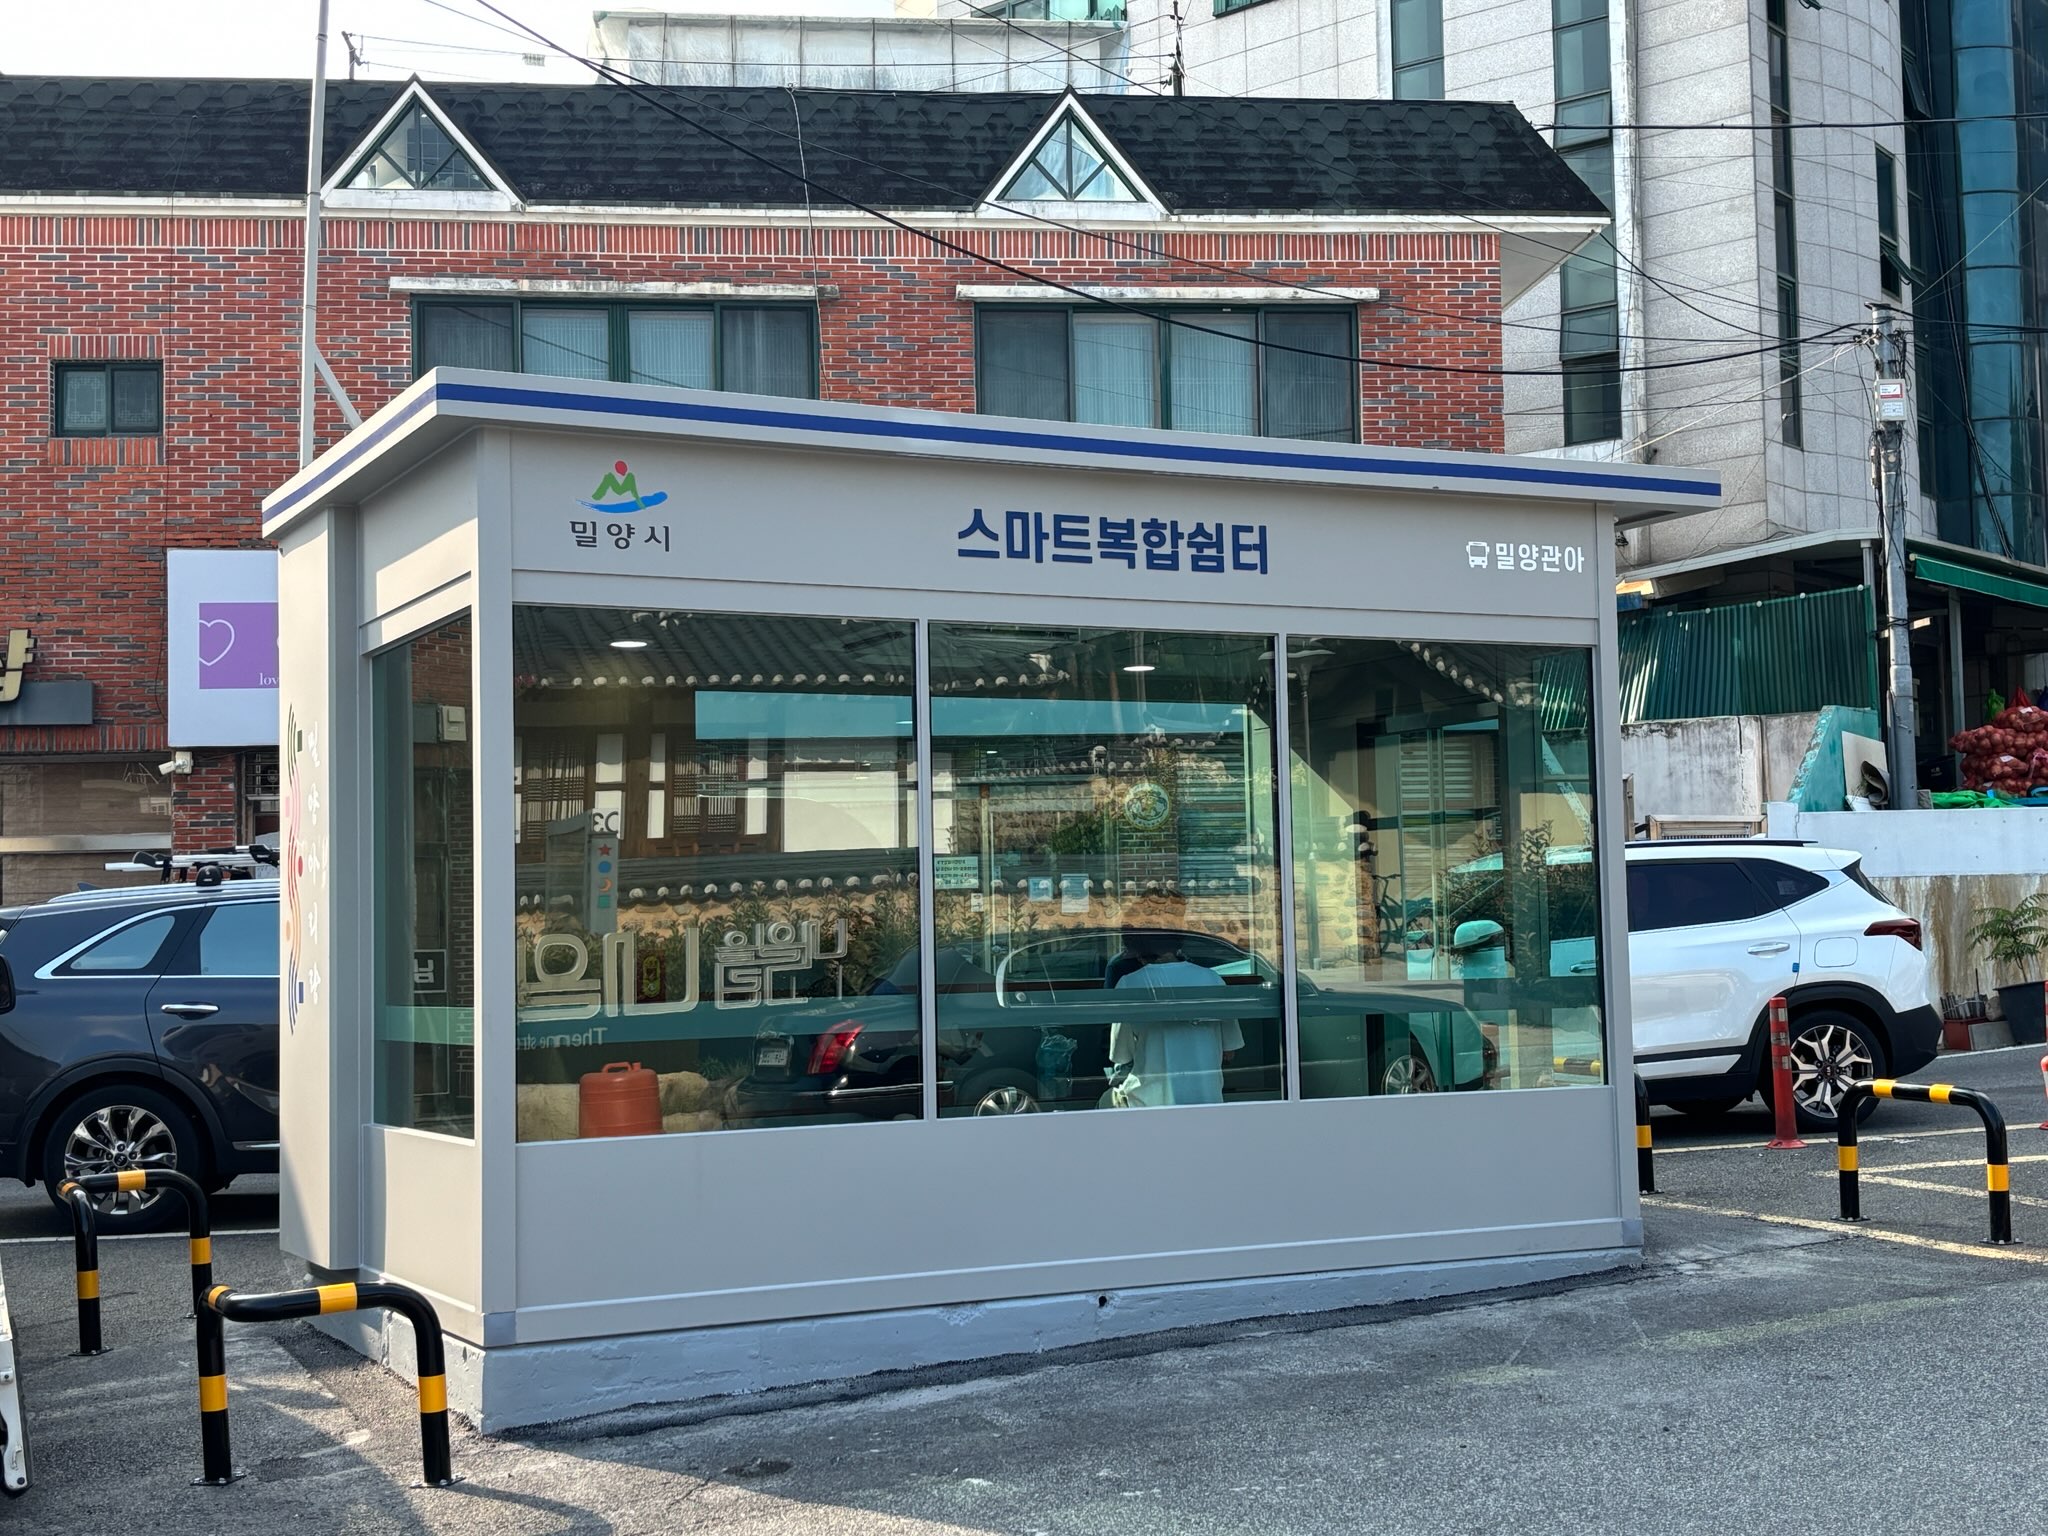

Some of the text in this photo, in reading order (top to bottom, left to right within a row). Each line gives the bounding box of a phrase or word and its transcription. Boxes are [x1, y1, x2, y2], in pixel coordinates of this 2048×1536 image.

[569, 520, 670, 552] 밀양시
[958, 508, 1268, 574] 스마트복합쉼터
[1495, 543, 1585, 573] 밀양관아
